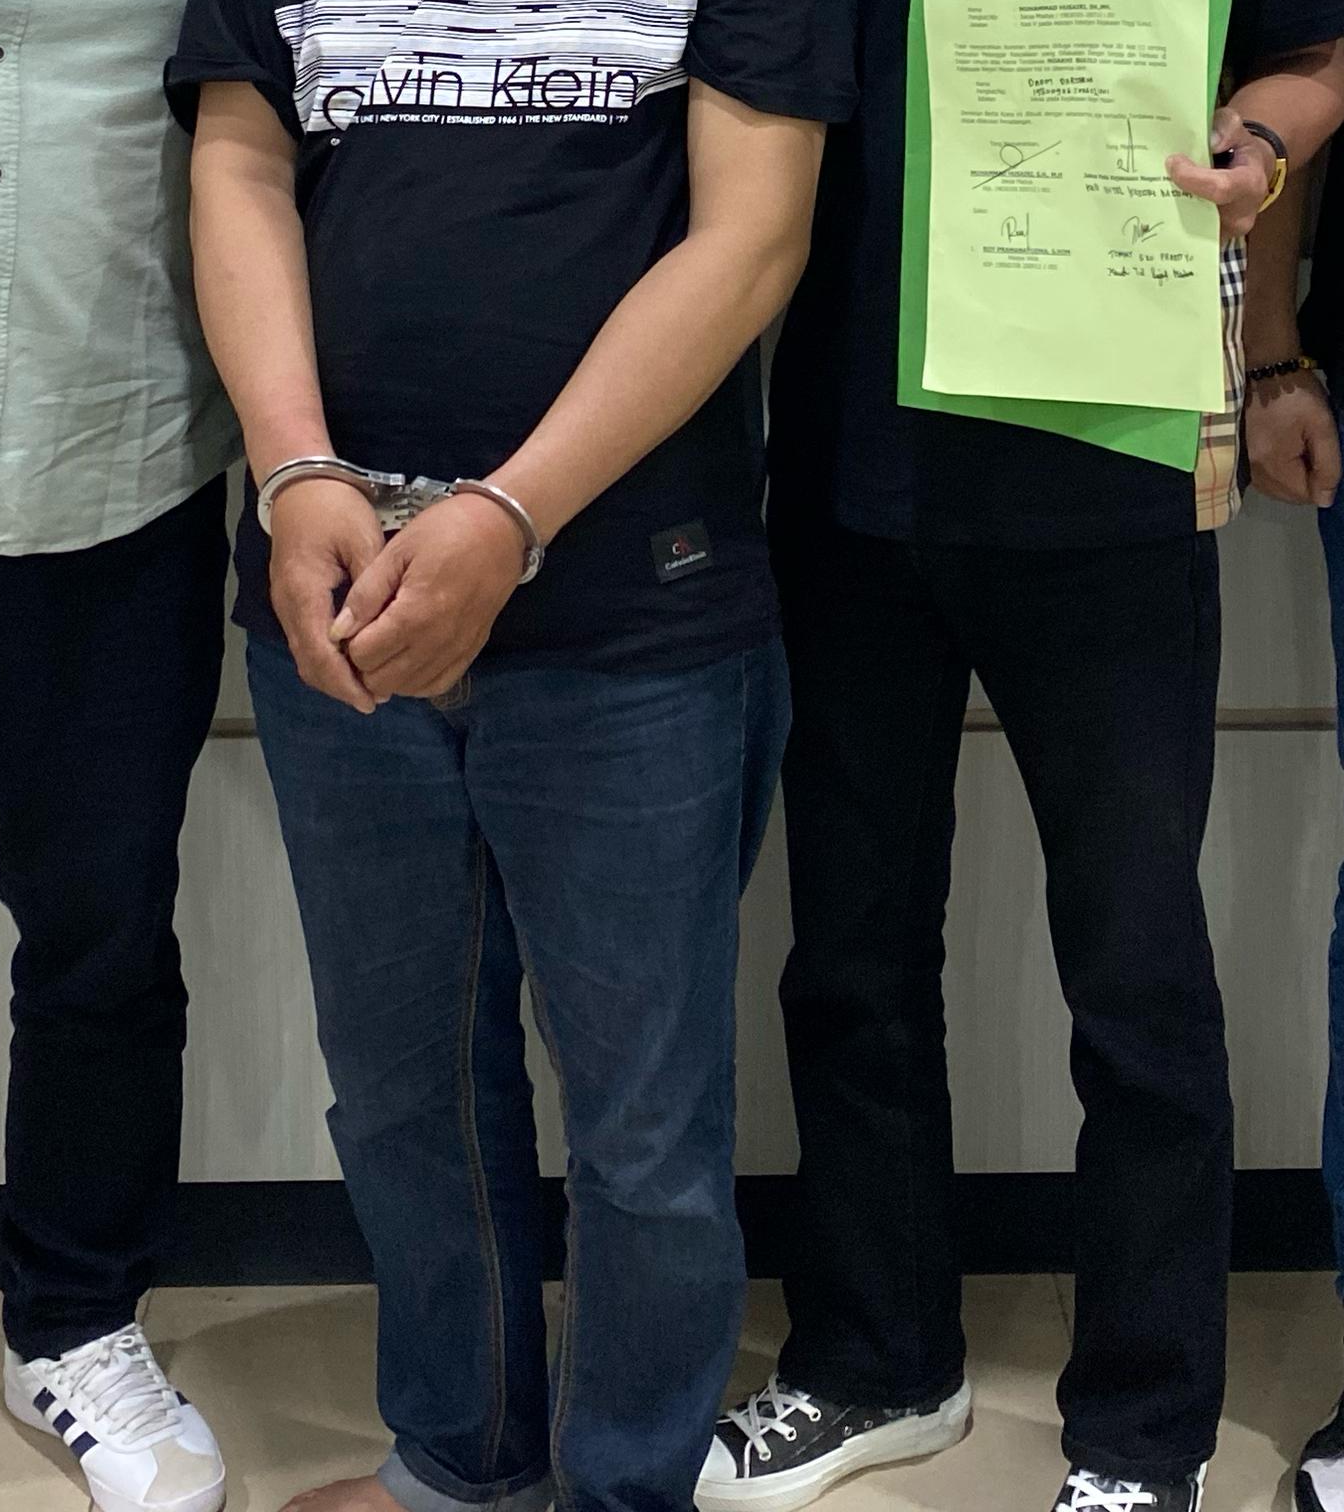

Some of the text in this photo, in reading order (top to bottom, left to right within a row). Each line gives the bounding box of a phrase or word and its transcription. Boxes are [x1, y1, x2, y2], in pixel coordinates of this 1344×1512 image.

[379, 114, 398, 124] NEW
[398, 114, 420, 123] YORK
[421, 114, 440, 124] CITY
[446, 115, 496, 125] ESTABLISHED
[525, 114, 541, 124] THE
[541, 114, 562, 123] NEW
[562, 113, 607, 123] STANDARD
